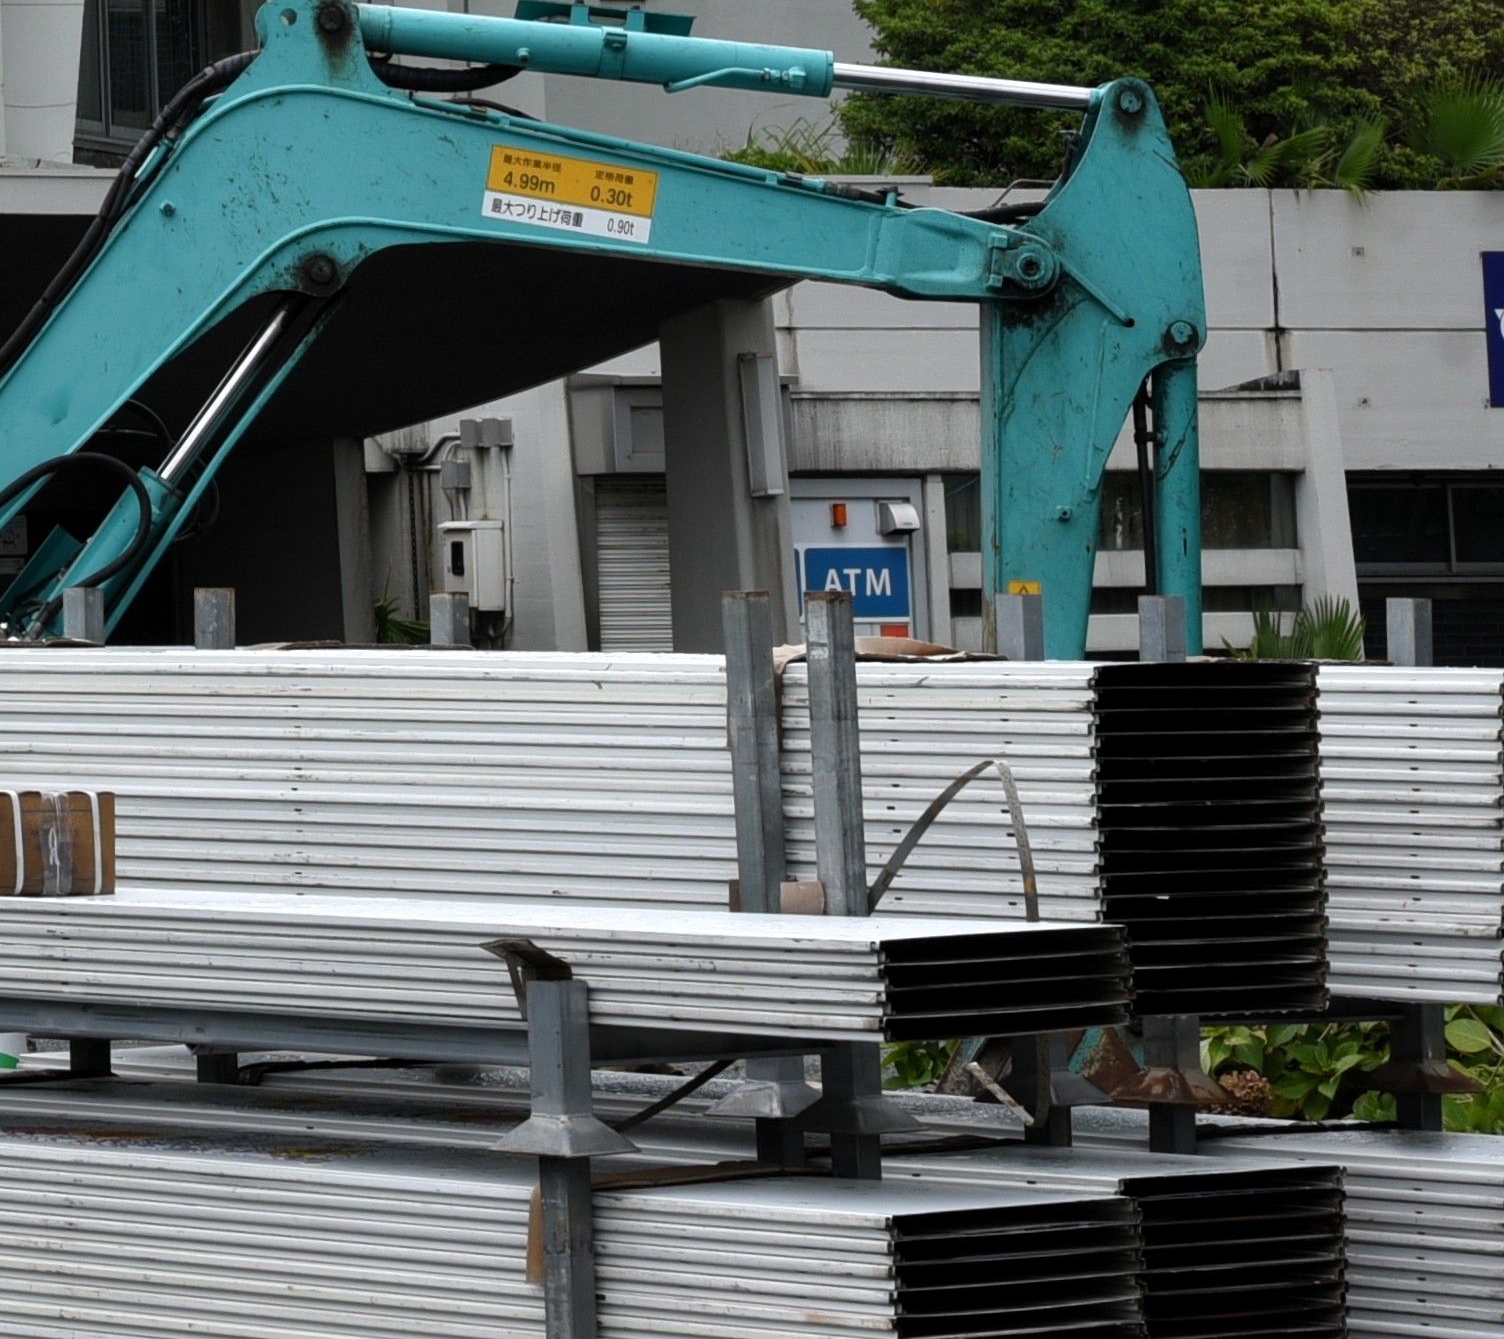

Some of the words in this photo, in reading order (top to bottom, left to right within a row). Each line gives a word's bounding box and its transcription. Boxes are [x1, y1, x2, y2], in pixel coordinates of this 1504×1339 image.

[503, 171, 555, 194] 4.99m
[590, 185, 633, 208] 0.30t
[491, 197, 584, 228] 最大つり上げ荷重
[607, 218, 635, 236] 0.90t
[824, 568, 892, 596] ATM
